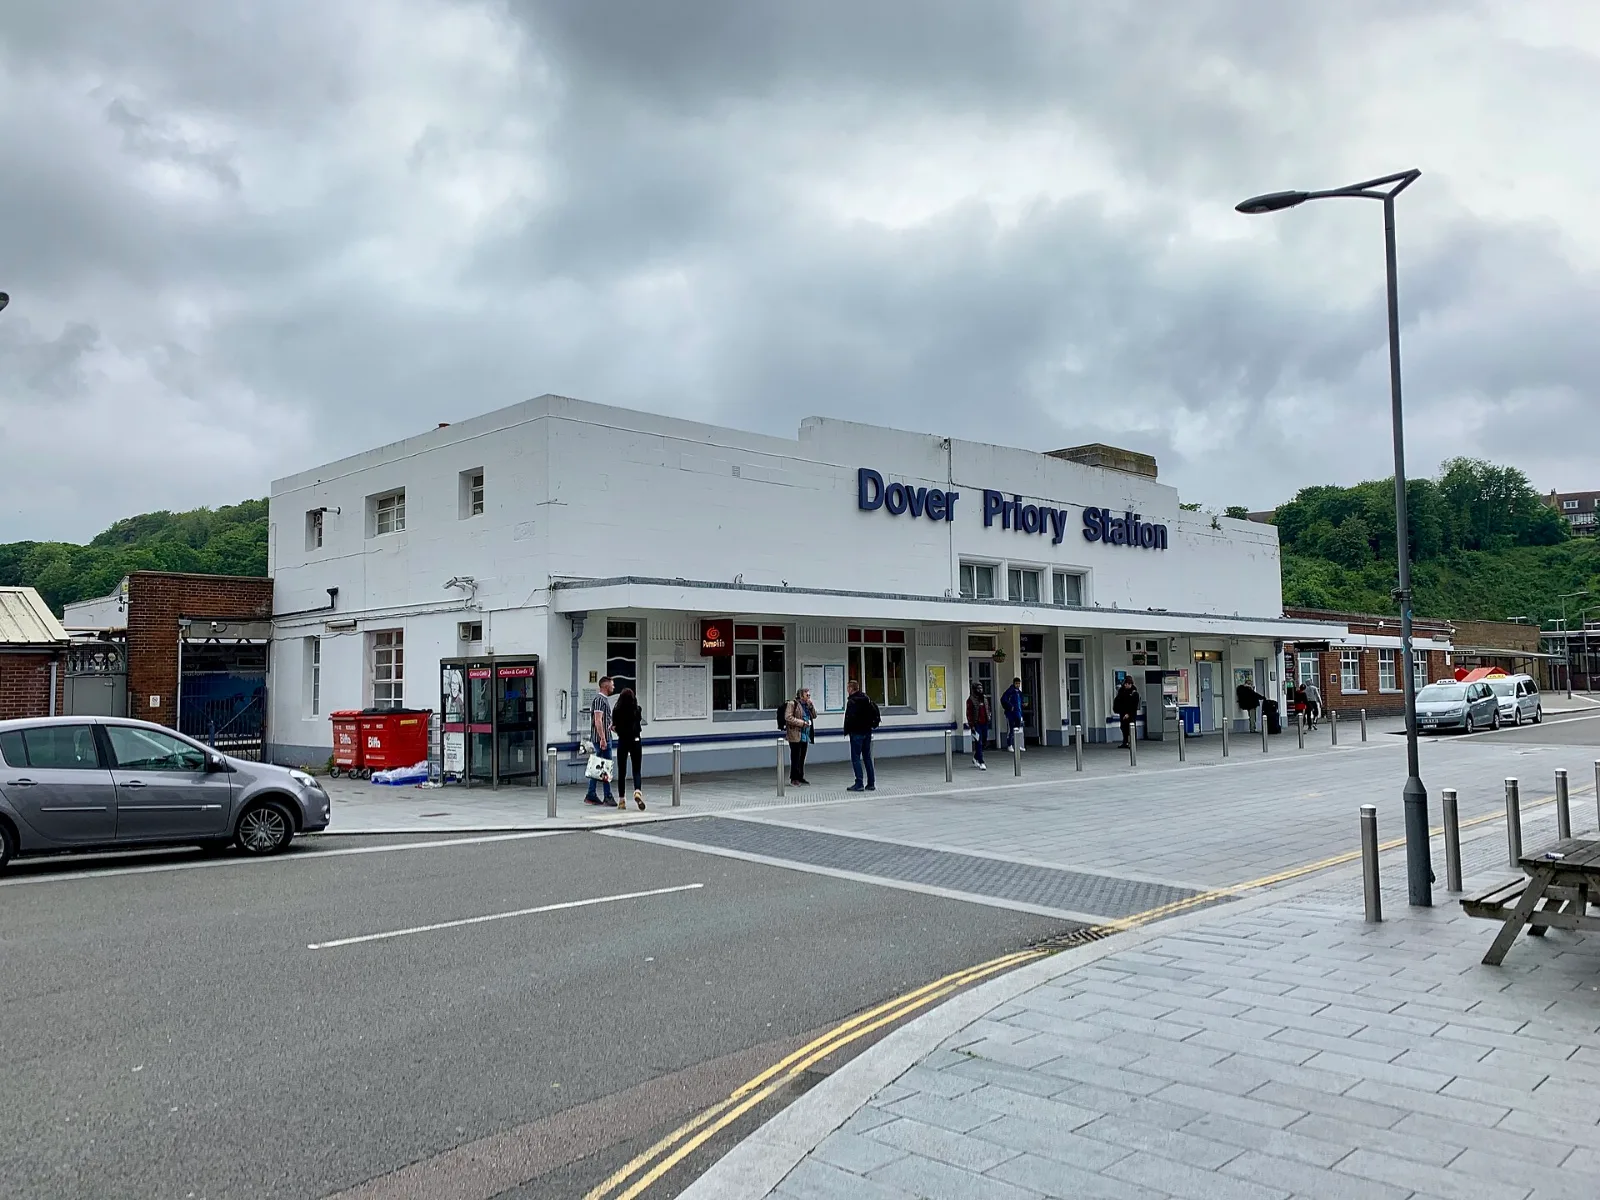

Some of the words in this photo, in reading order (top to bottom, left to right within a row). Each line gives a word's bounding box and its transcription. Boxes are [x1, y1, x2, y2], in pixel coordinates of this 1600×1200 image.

[858, 467, 959, 521] Dover
[983, 489, 1067, 545] Priory
[1082, 505, 1168, 550] Station
